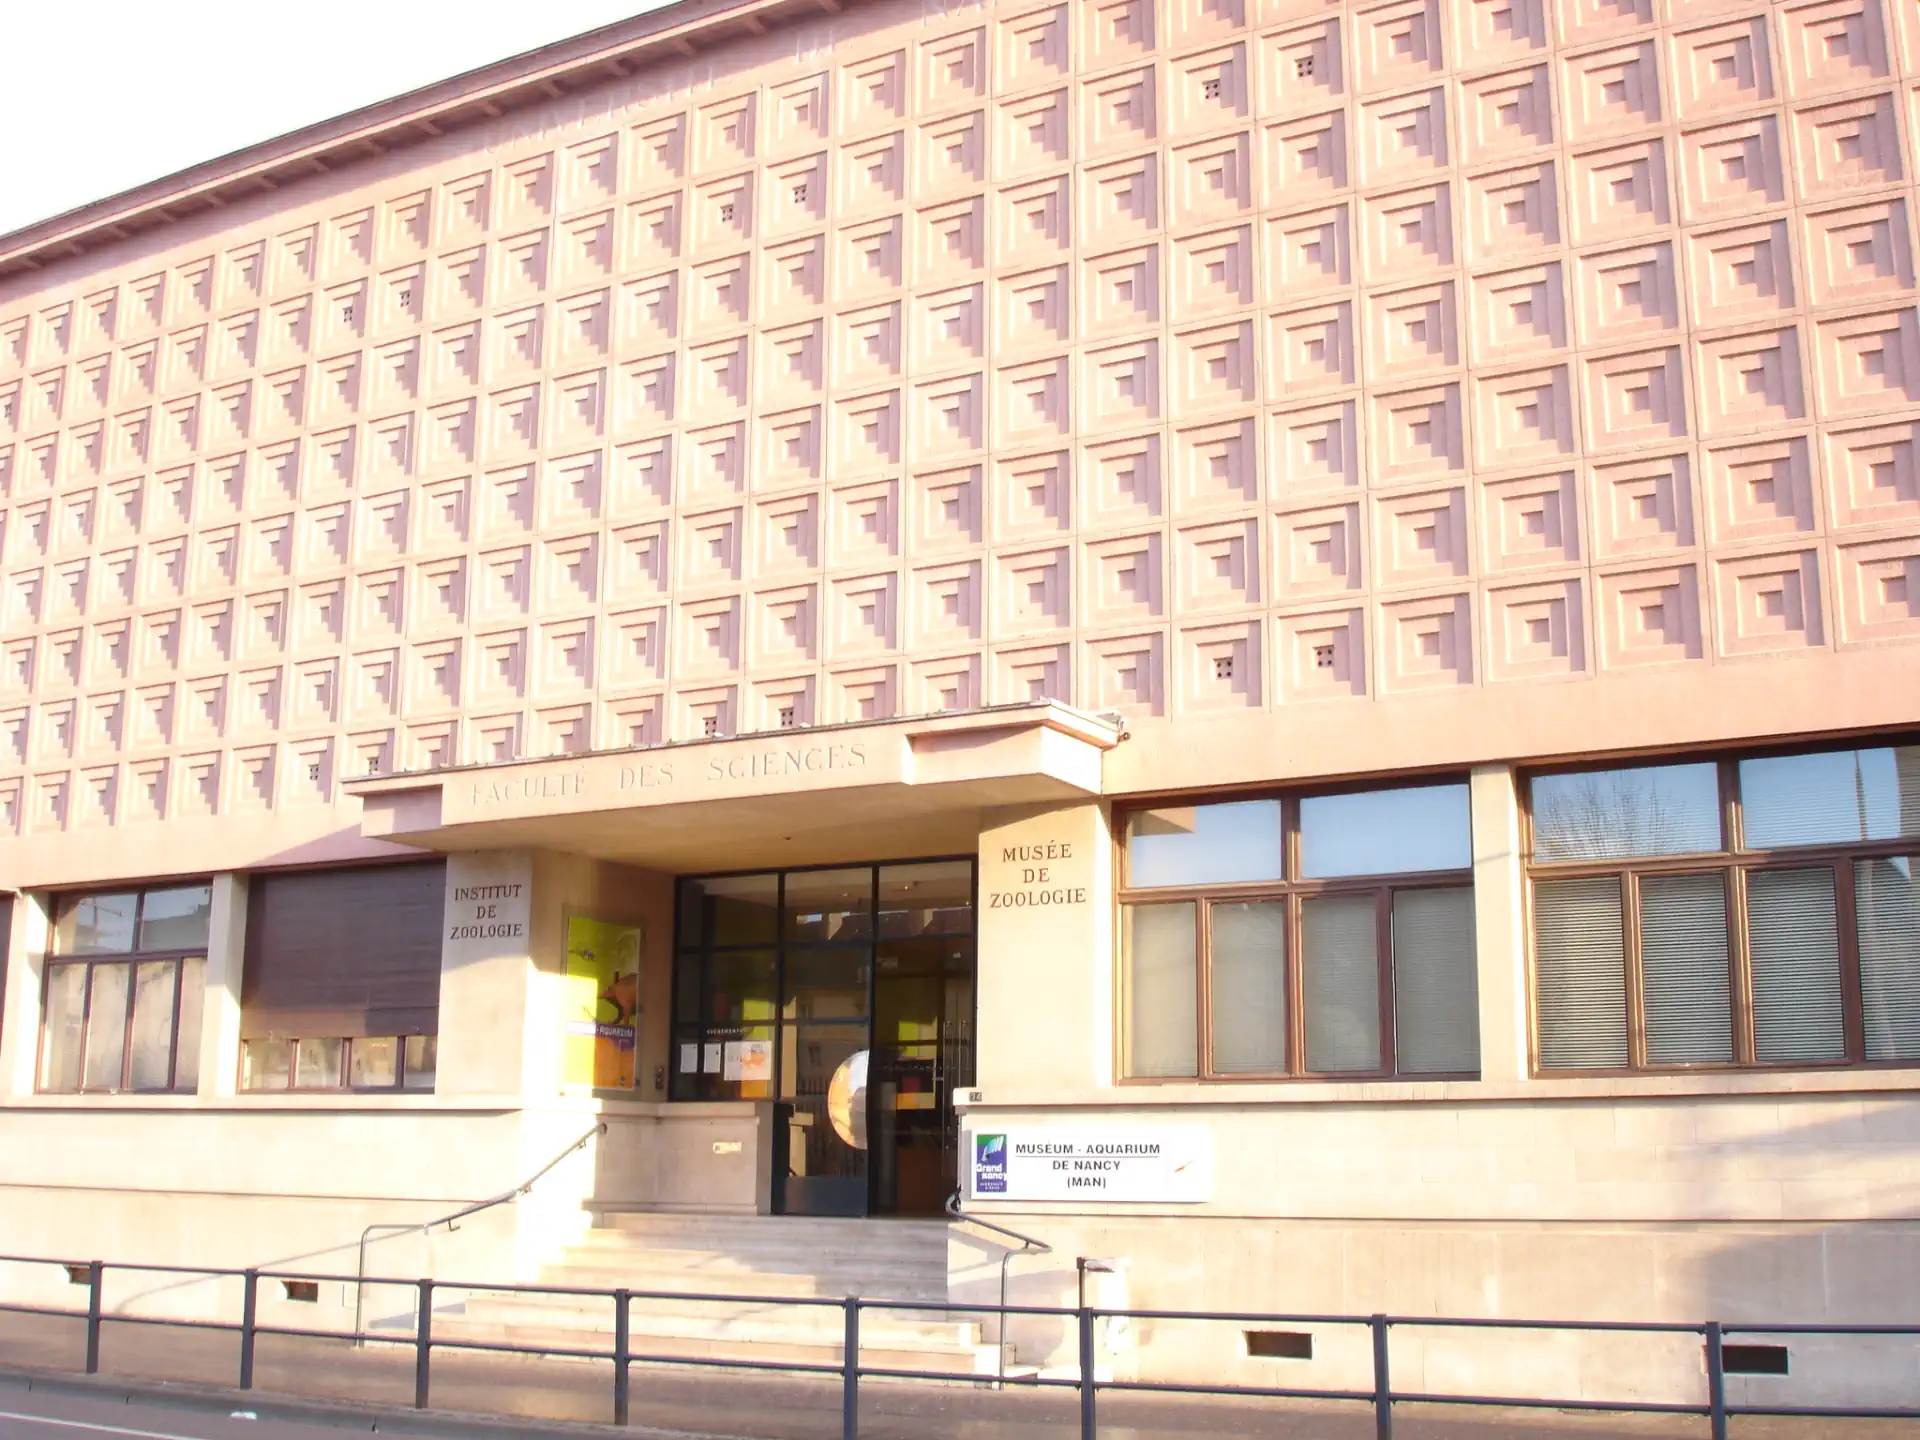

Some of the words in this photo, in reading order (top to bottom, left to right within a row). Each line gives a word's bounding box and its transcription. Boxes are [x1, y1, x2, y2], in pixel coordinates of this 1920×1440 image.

[619, 764, 674, 790] DES
[708, 743, 867, 783] SCIENCES
[1003, 840, 1072, 862] MUSÉE
[1022, 868, 1050, 883] DE
[454, 884, 522, 901] INSTITUT
[989, 888, 1086, 908] ZOOLOGIE
[476, 905, 497, 920] DE
[450, 924, 522, 940] ZOOLOGIE
[1086, 1144, 1160, 1154] AQUARIUM
[976, 1163, 1003, 1173] Grand
[1053, 1160, 1069, 1170] DE
[1074, 1160, 1121, 1171] NANCY
[1067, 1177, 1107, 1188] (MAN)
